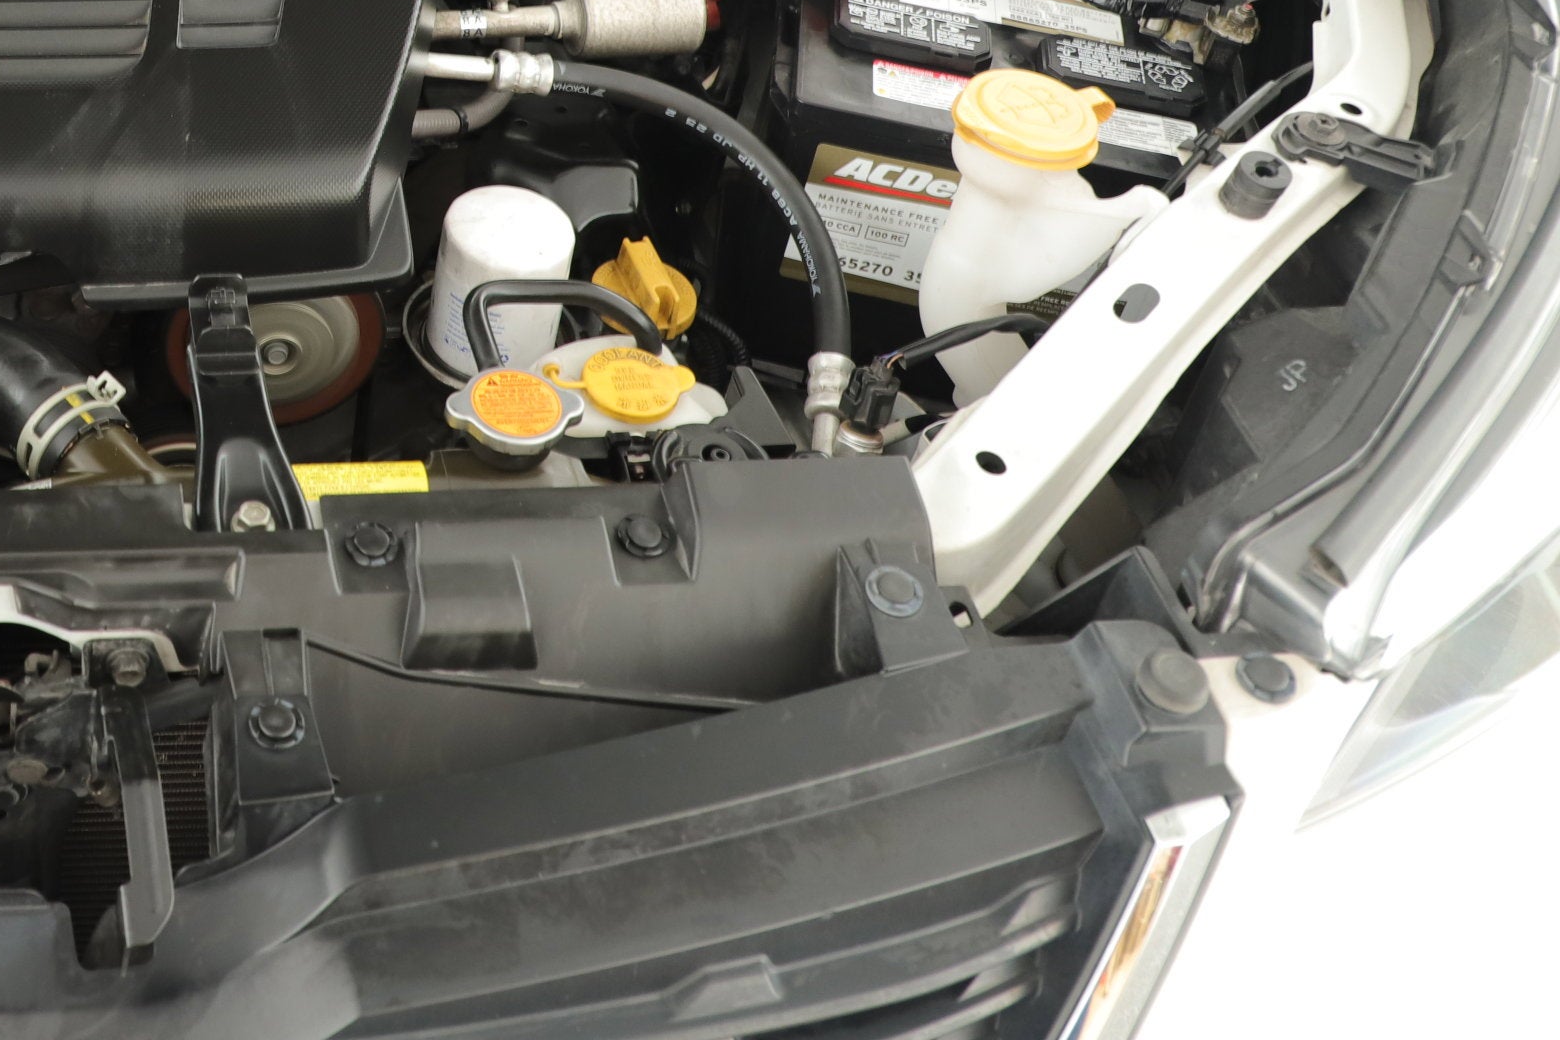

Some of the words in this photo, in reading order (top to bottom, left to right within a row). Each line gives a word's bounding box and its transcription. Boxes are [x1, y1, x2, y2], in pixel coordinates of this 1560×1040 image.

[926, 10, 970, 24] POISON
[834, 157, 958, 199] ACDe
[814, 202, 863, 219] BATTERIE
[867, 213, 894, 225] SANS
[818, 193, 904, 218] MAINTENANCE
[908, 212, 938, 225] FREE
[836, 223, 855, 233] CCA
[870, 230, 888, 240] 100
[890, 235, 905, 243] RC
[797, 231, 817, 282] YOKOHAMA
